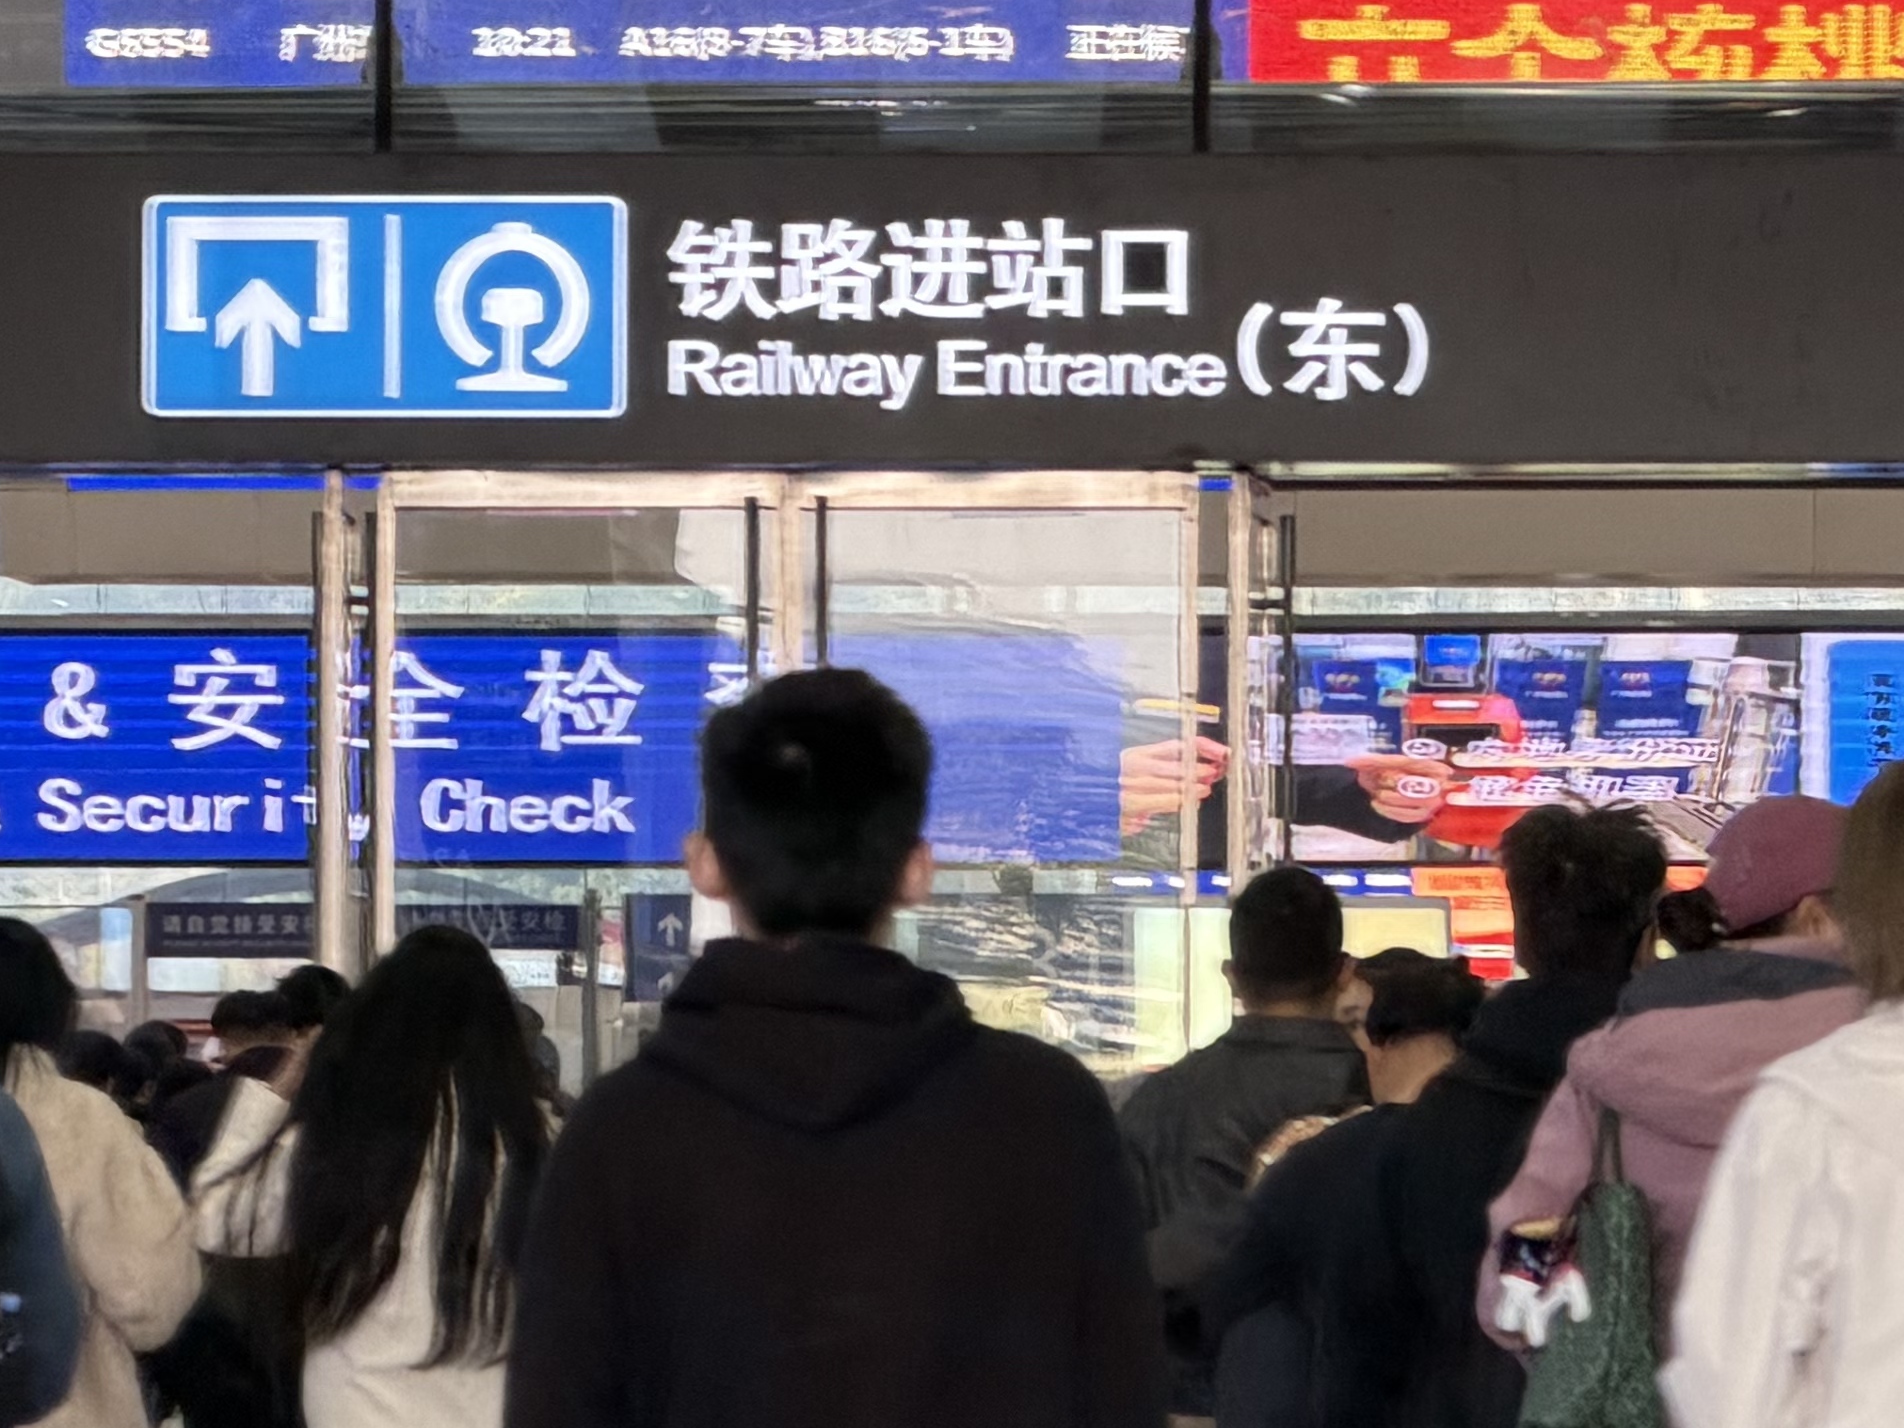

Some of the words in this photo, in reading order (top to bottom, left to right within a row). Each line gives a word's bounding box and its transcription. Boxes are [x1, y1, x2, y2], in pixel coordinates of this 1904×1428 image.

[668, 219, 1189, 321] 铁路进站口
[669, 341, 924, 411] Railway
[939, 341, 1228, 397] Entrance
[46, 664, 109, 739] &
[422, 780, 635, 832] Check
